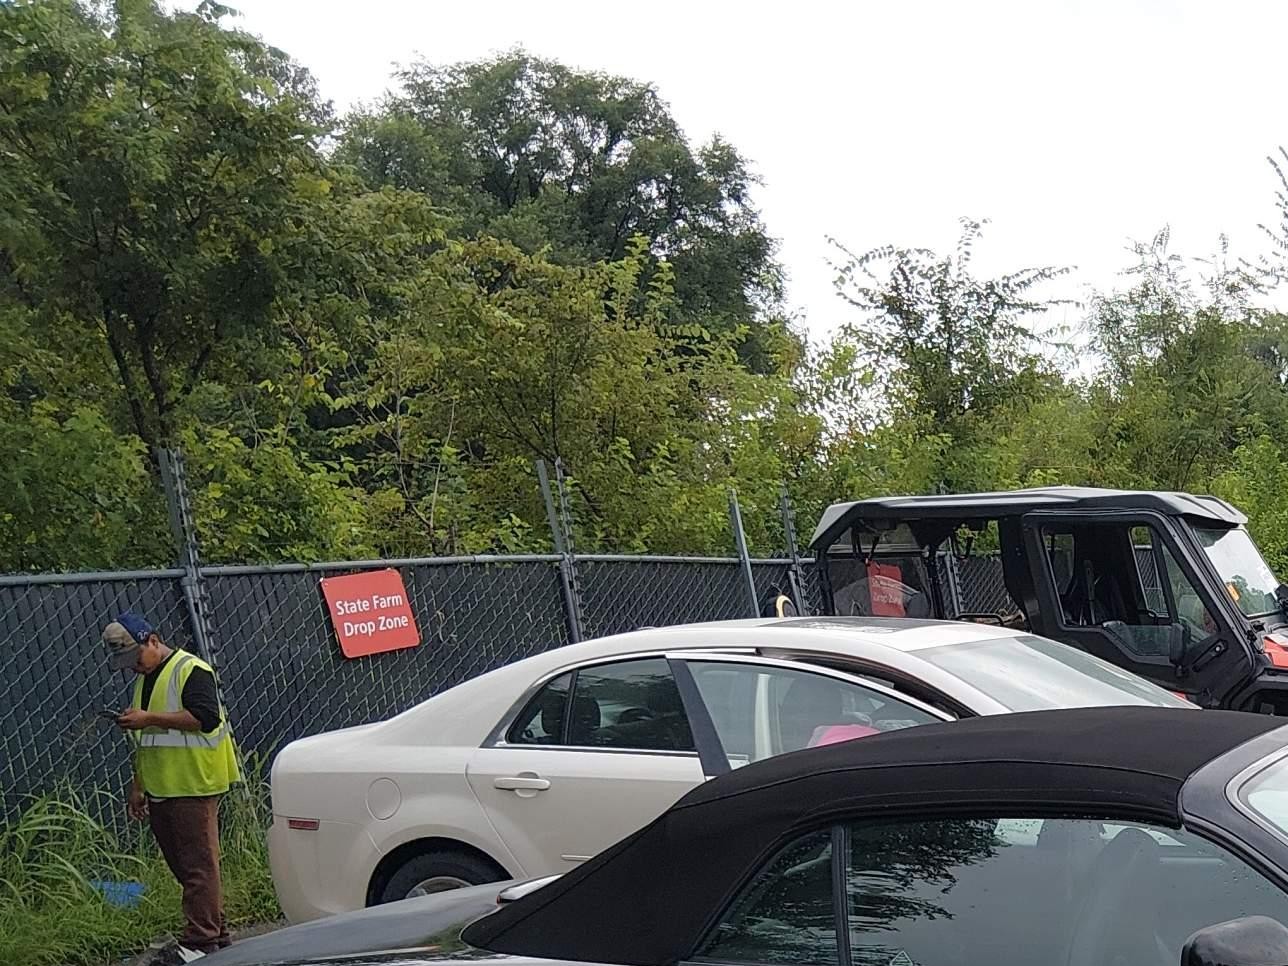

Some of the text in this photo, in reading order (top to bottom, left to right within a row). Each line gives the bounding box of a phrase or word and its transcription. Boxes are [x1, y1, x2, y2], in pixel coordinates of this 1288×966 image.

[335, 594, 403, 616] State Farm
[343, 615, 409, 637] Drop Zone
